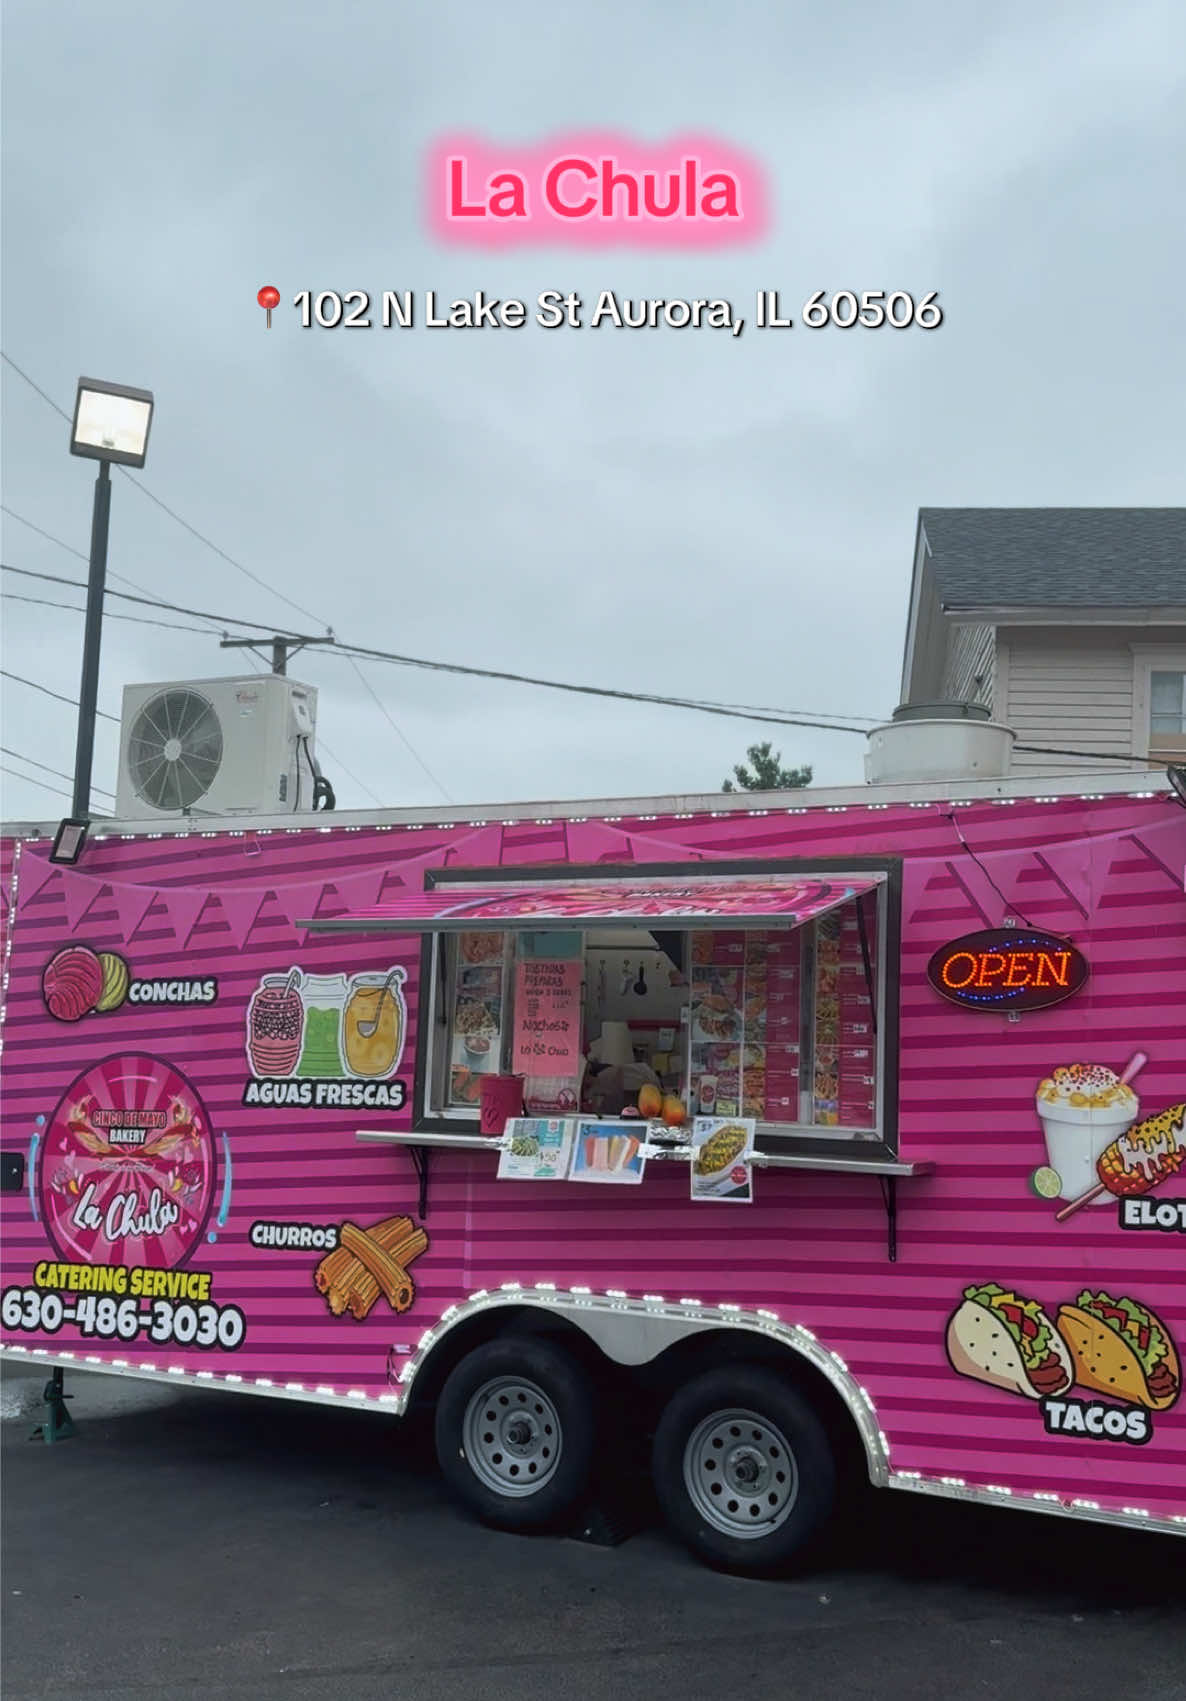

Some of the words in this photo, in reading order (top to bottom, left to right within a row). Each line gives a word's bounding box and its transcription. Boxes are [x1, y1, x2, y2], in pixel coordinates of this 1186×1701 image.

[942, 952, 1072, 989] OPEN
[129, 981, 215, 1002] CONCHAS
[245, 1082, 313, 1104] AGUAS
[315, 1084, 403, 1107] FRESCAS
[94, 1110, 122, 1127] CINCO
[124, 1111, 137, 1127] DE
[138, 1112, 165, 1128] MAYO
[109, 1128, 147, 1143] BAKERY
[73, 1183, 102, 1229] La
[105, 1188, 179, 1241] Chula
[252, 1225, 337, 1249] CHURROS
[34, 1262, 127, 1294] CATERING
[130, 1268, 211, 1300] SERVICE
[2, 1289, 243, 1347] 630-486-3030
[1046, 1402, 1147, 1440] TACOS
